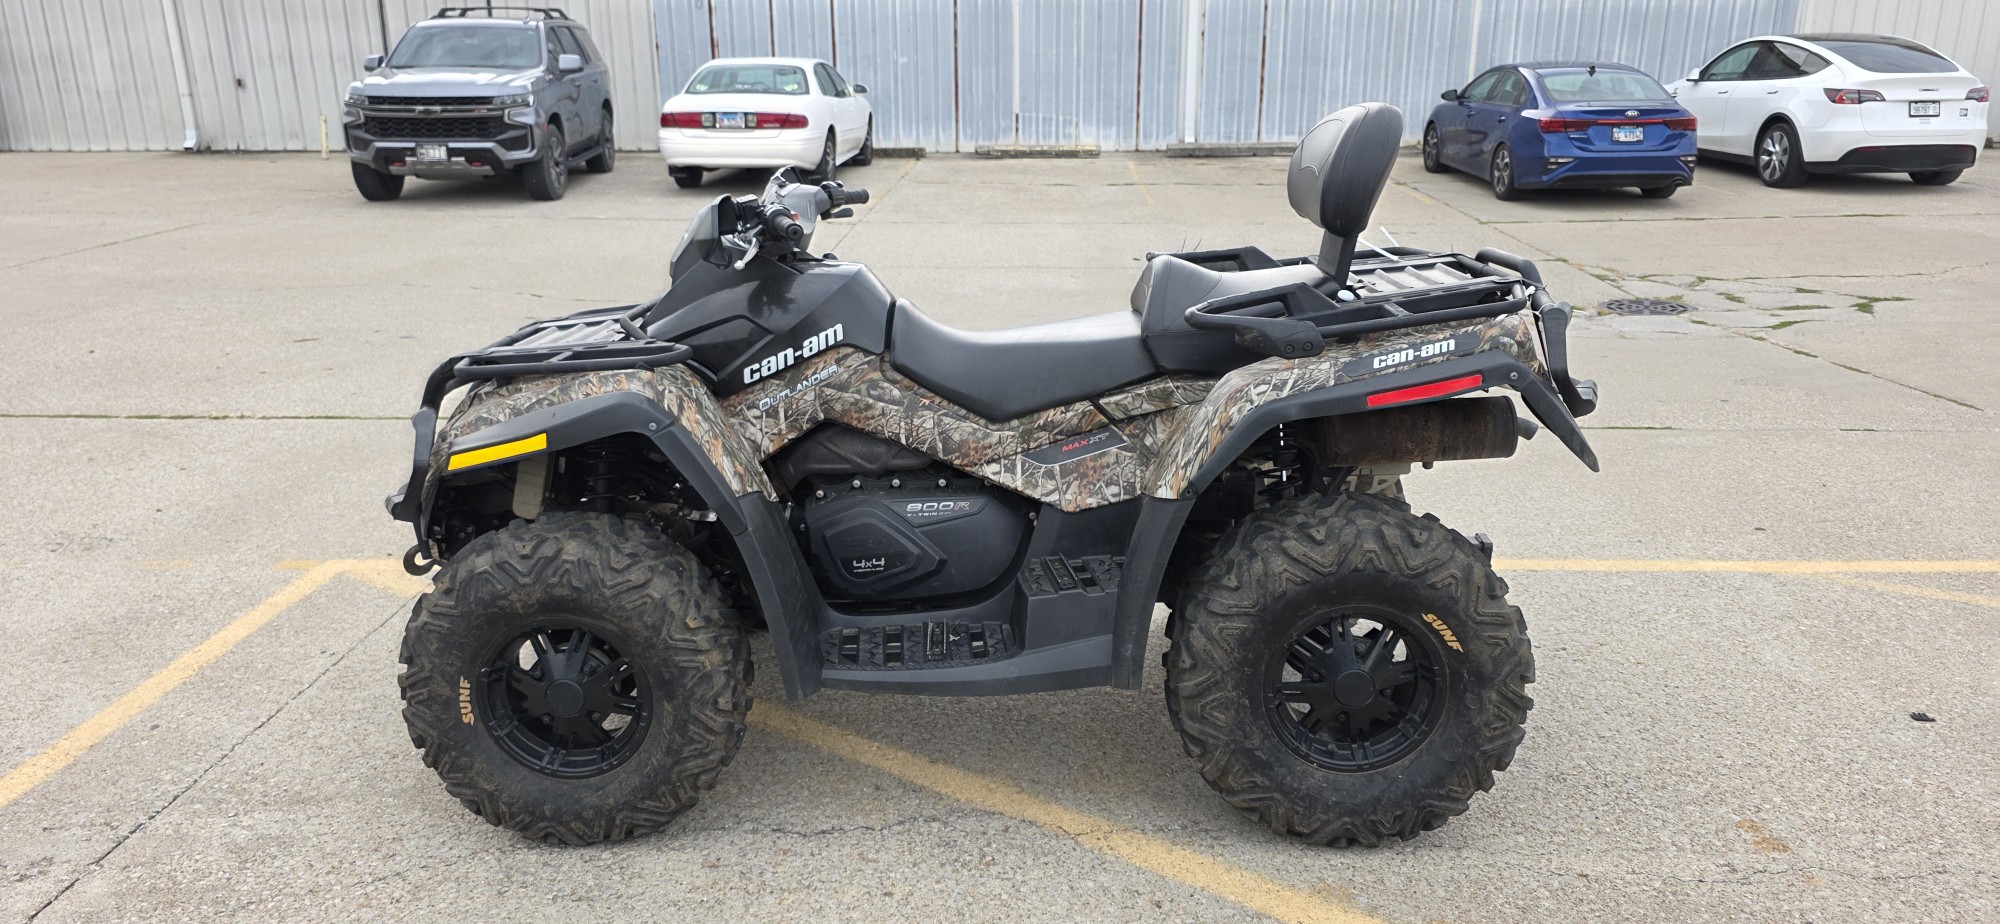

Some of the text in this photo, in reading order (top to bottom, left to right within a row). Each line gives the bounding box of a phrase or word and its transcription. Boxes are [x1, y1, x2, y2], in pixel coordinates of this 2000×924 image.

[743, 323, 844, 385] can-am
[1373, 339, 1456, 369] can-am
[759, 364, 840, 412] OUTLANDER
[1062, 438, 1089, 452] MAX
[906, 501, 970, 512] 800R
[853, 557, 885, 568] 4x4
[1420, 612, 1464, 653] SUNF
[459, 674, 475, 727] SUNF
